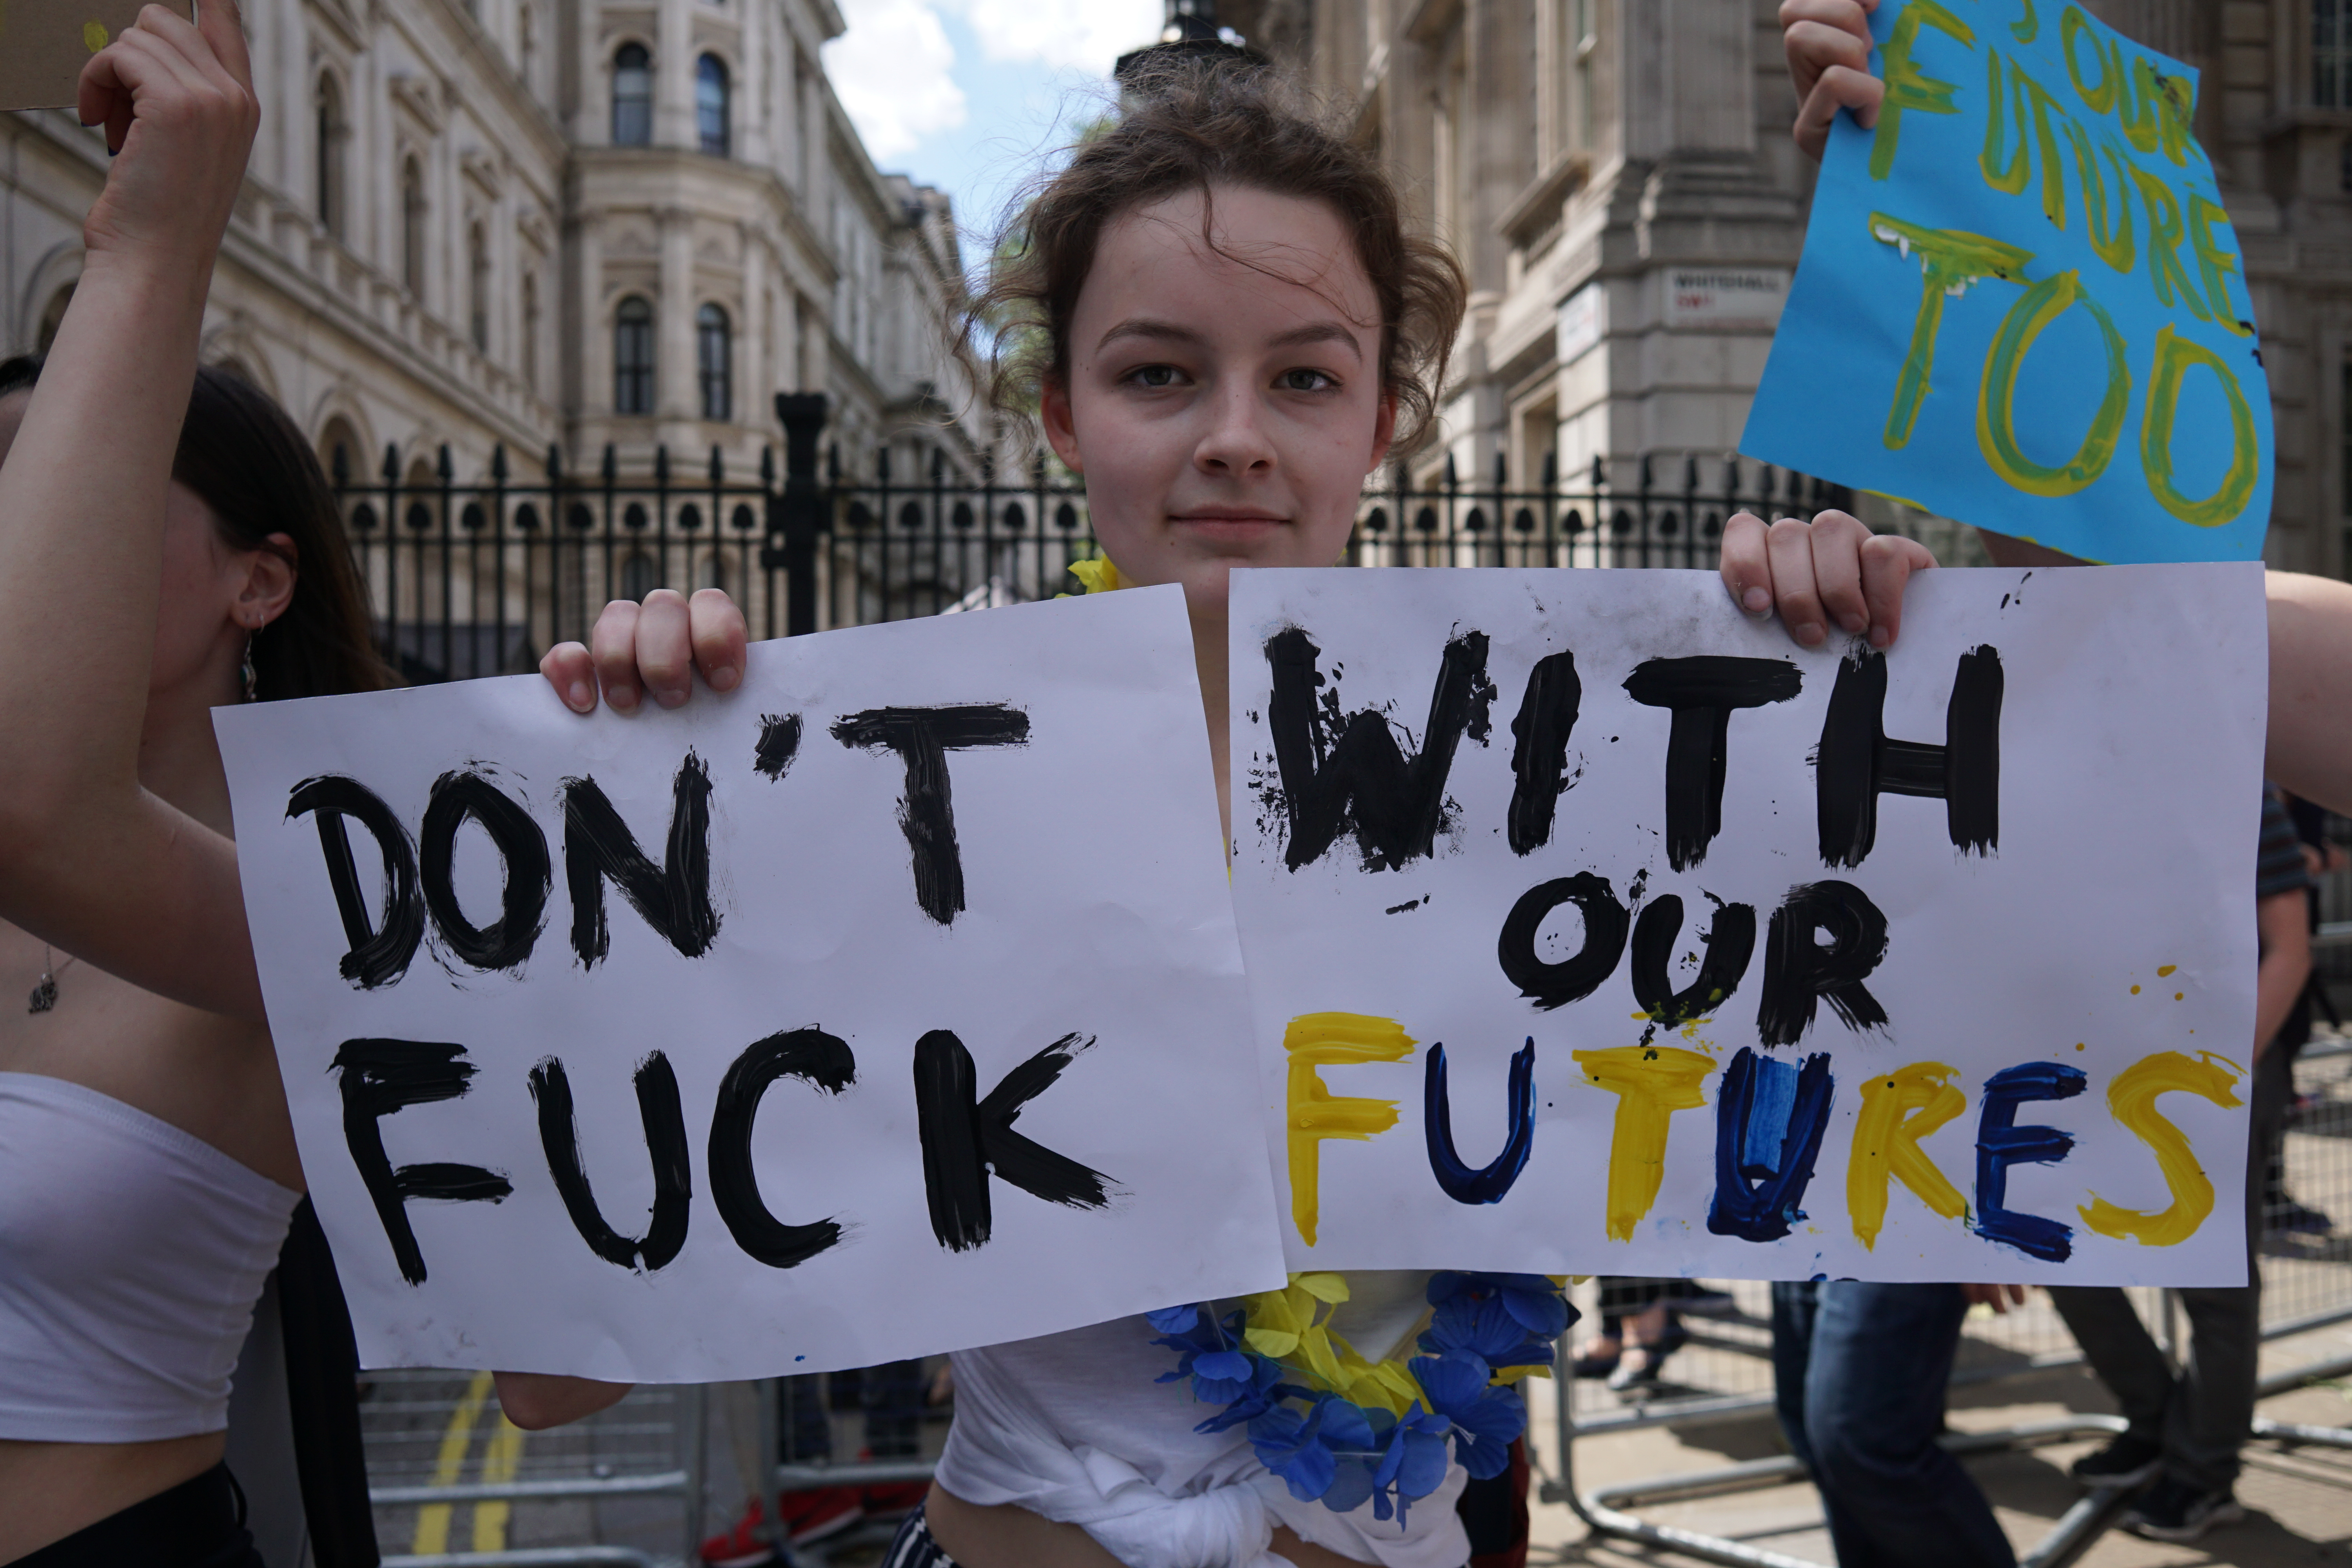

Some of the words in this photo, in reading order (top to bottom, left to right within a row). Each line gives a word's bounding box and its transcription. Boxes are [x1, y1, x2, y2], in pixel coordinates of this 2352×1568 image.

[1869, 0, 2255, 337] FUTURE
[1868, 211, 2258, 527] TOO
[284, 703, 1030, 989] DON'T
[1264, 624, 2004, 873] WITH
[1498, 871, 1890, 1047] OUR
[327, 1023, 1126, 1286] FUCK
[1283, 1011, 2245, 1262] FUTURES
